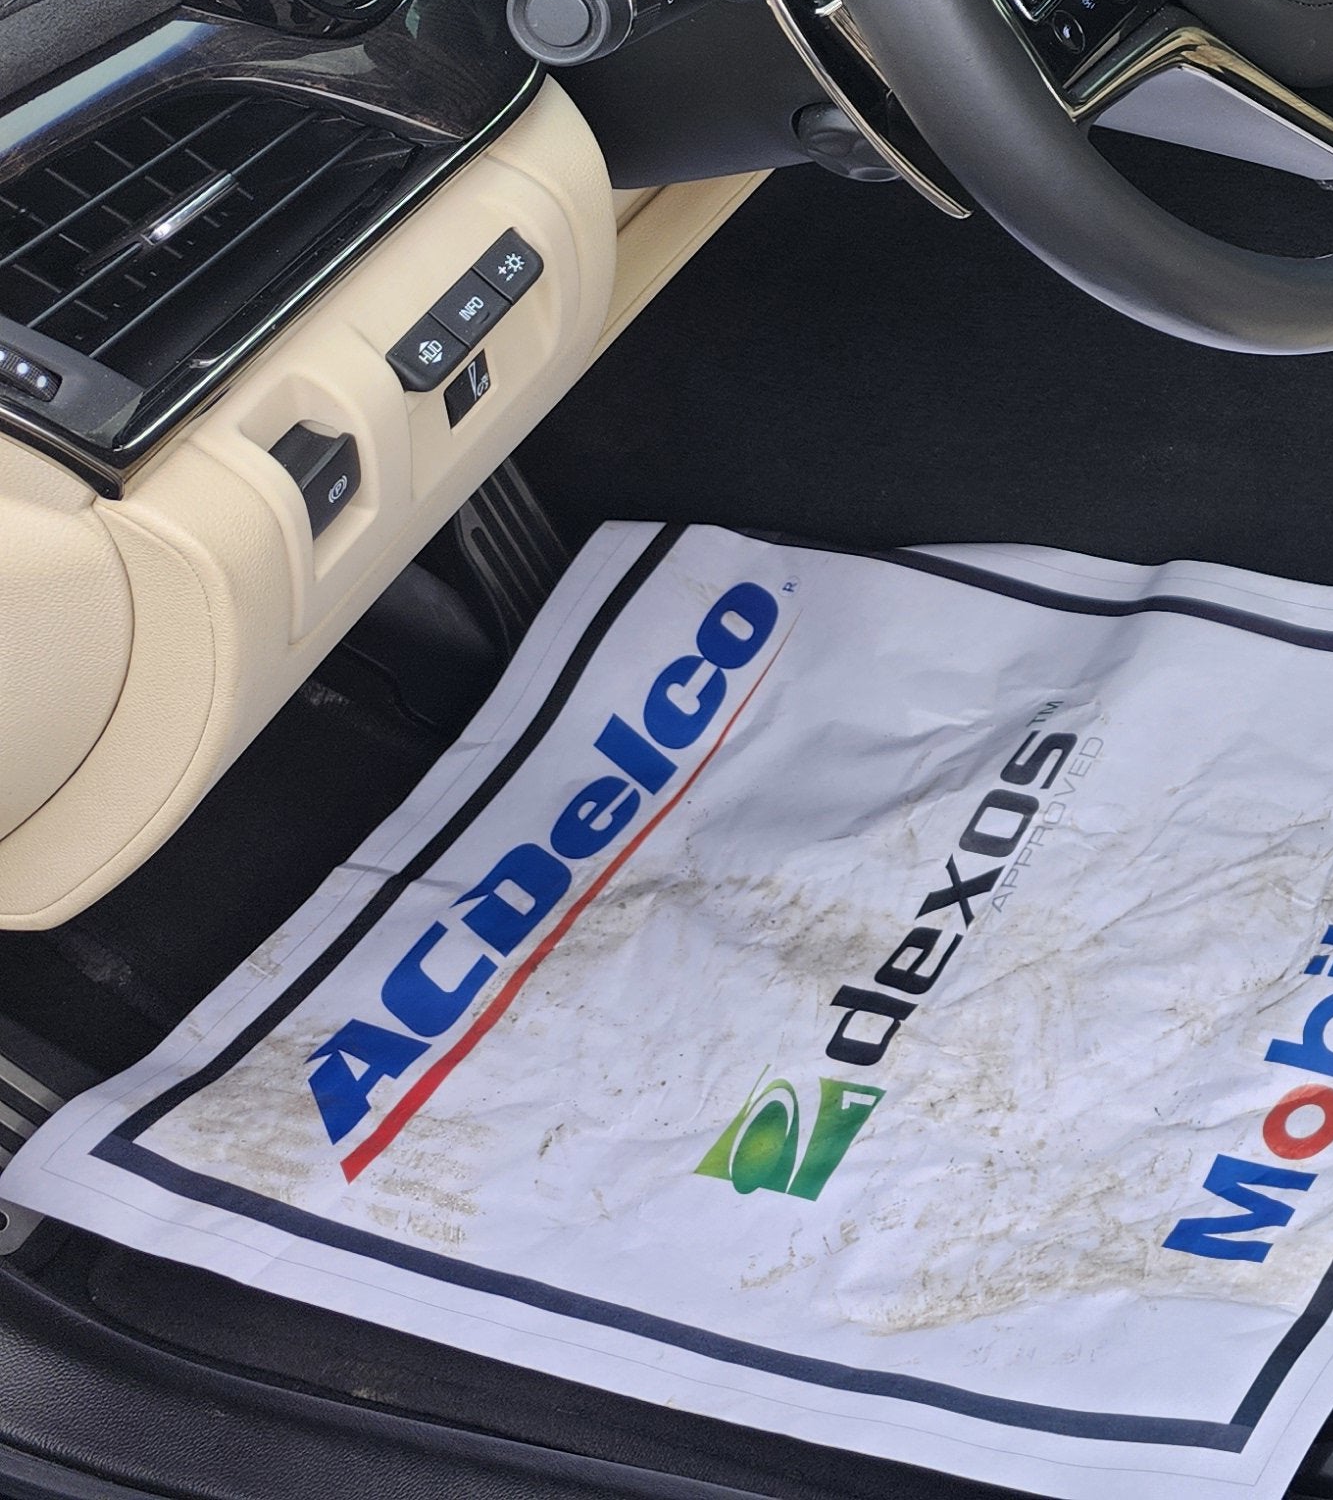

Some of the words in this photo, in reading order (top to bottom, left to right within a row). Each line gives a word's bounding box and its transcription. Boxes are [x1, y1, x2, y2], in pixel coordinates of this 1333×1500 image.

[418, 339, 443, 365] HUD
[458, 296, 484, 321] INFO
[303, 581, 779, 1146] ACDelco
[825, 730, 1078, 1066] dexos
[991, 736, 1104, 914] APPROVED
